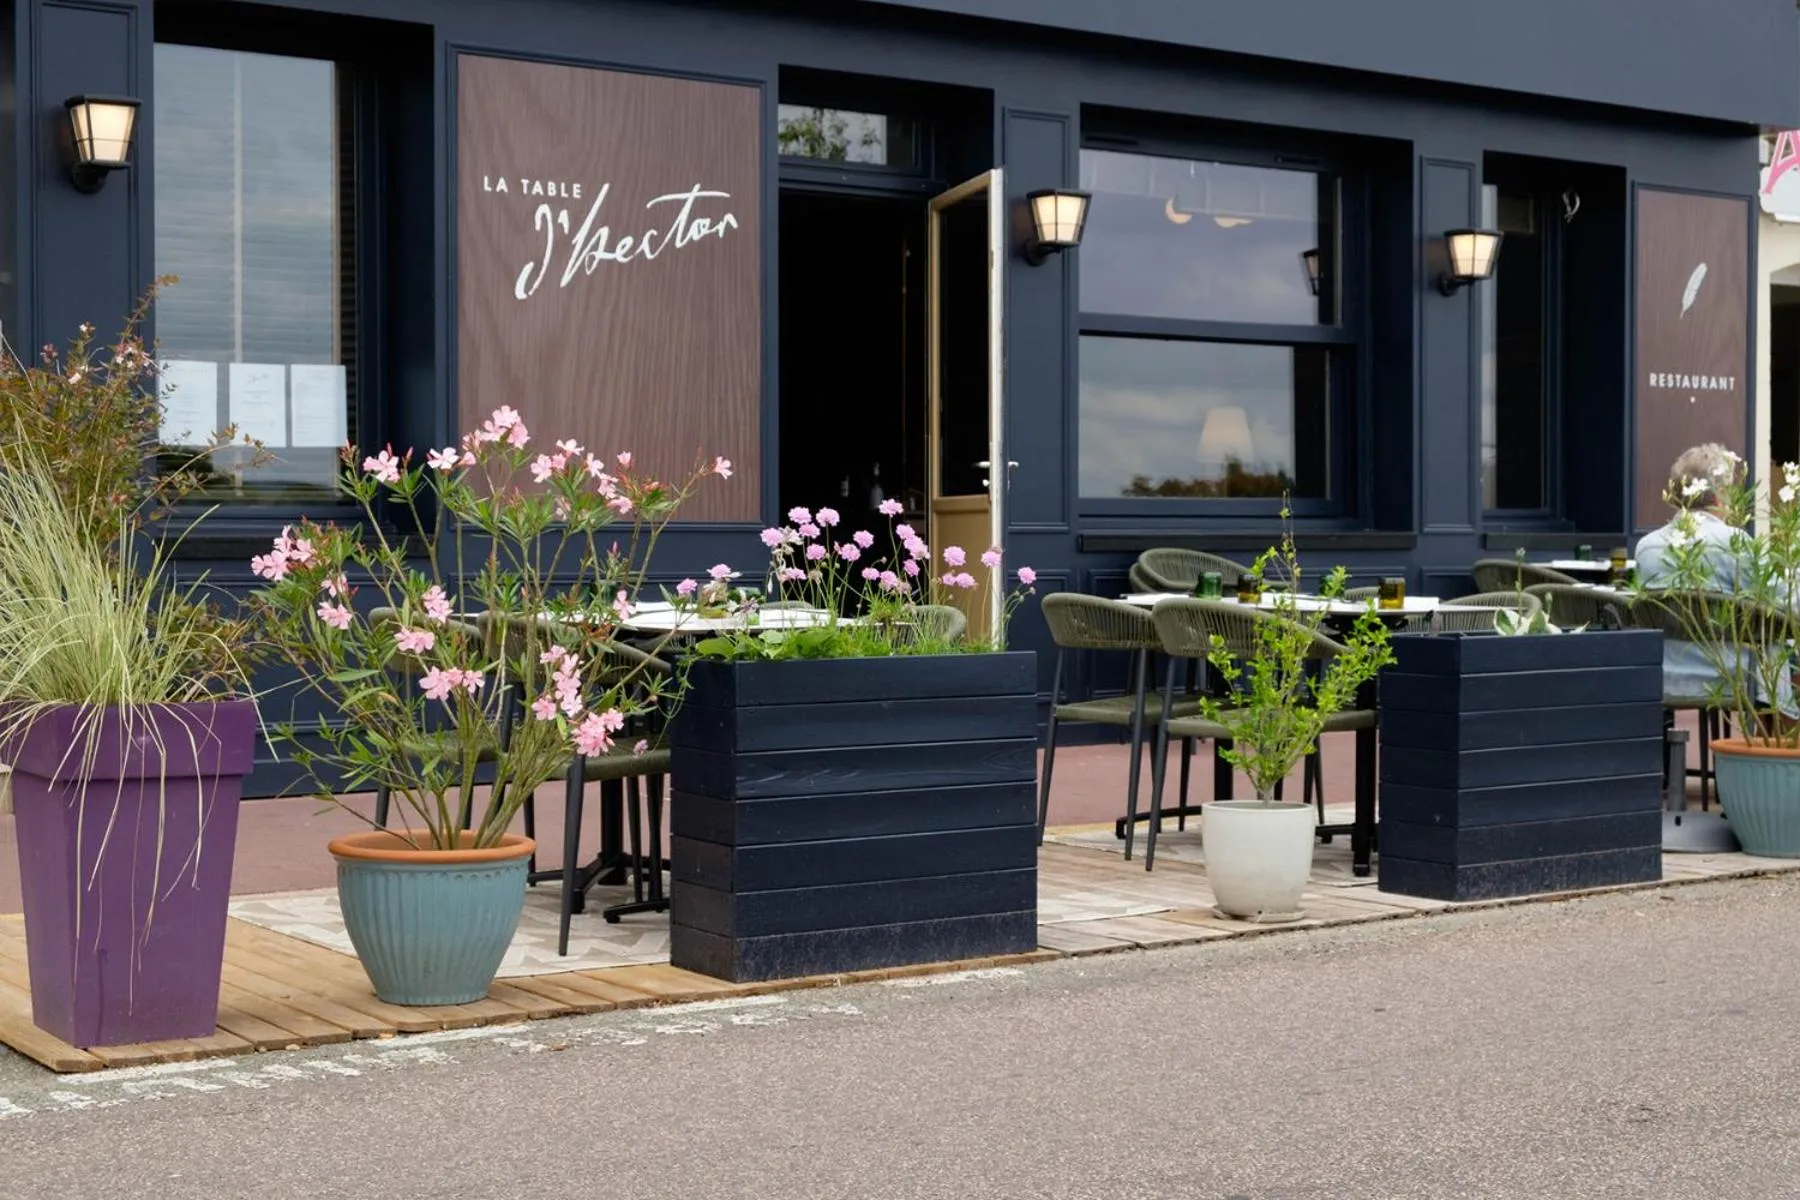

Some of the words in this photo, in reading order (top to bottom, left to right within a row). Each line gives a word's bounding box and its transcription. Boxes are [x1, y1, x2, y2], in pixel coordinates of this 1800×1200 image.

[483, 175, 509, 193] LA
[520, 178, 582, 199] TABLE
[1649, 372, 1736, 391] RESTAURANT
